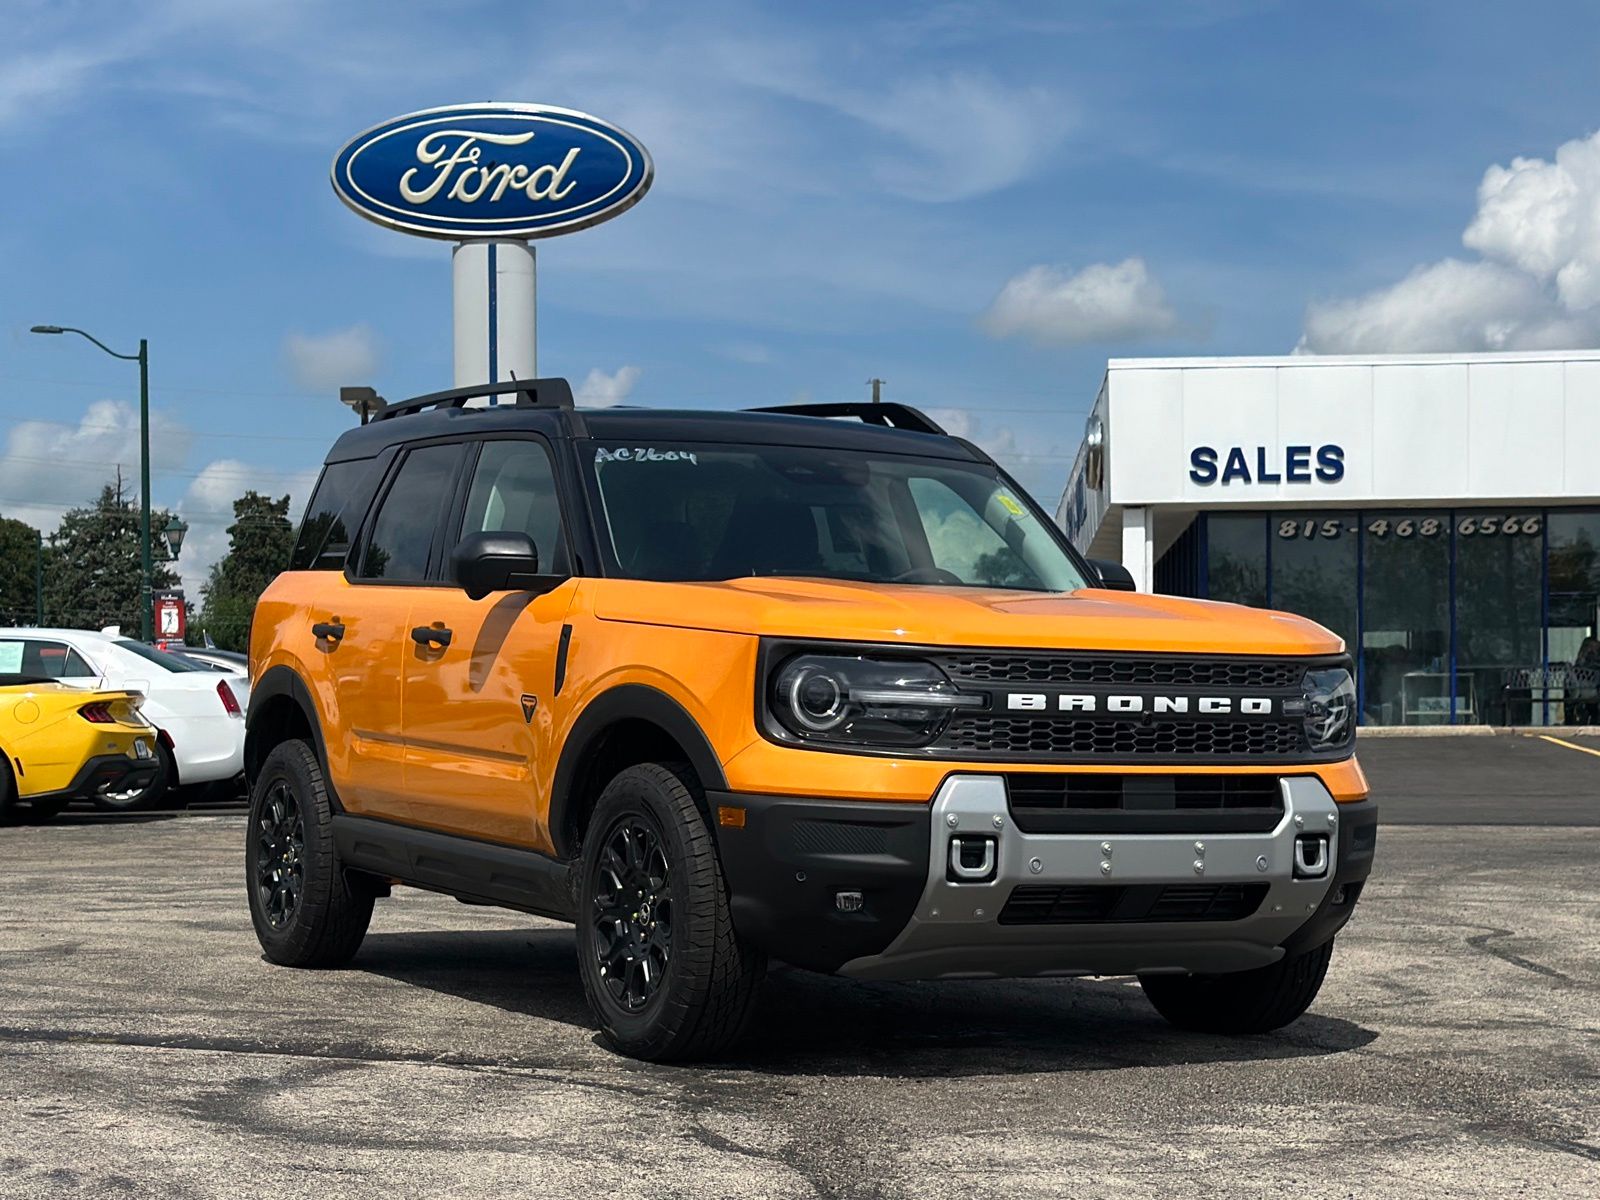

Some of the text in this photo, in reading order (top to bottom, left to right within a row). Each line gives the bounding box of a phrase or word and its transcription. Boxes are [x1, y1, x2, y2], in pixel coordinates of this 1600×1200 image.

[399, 129, 581, 205] Ford
[1189, 444, 1345, 487] SALES
[1007, 693, 1272, 714] BRONCO
